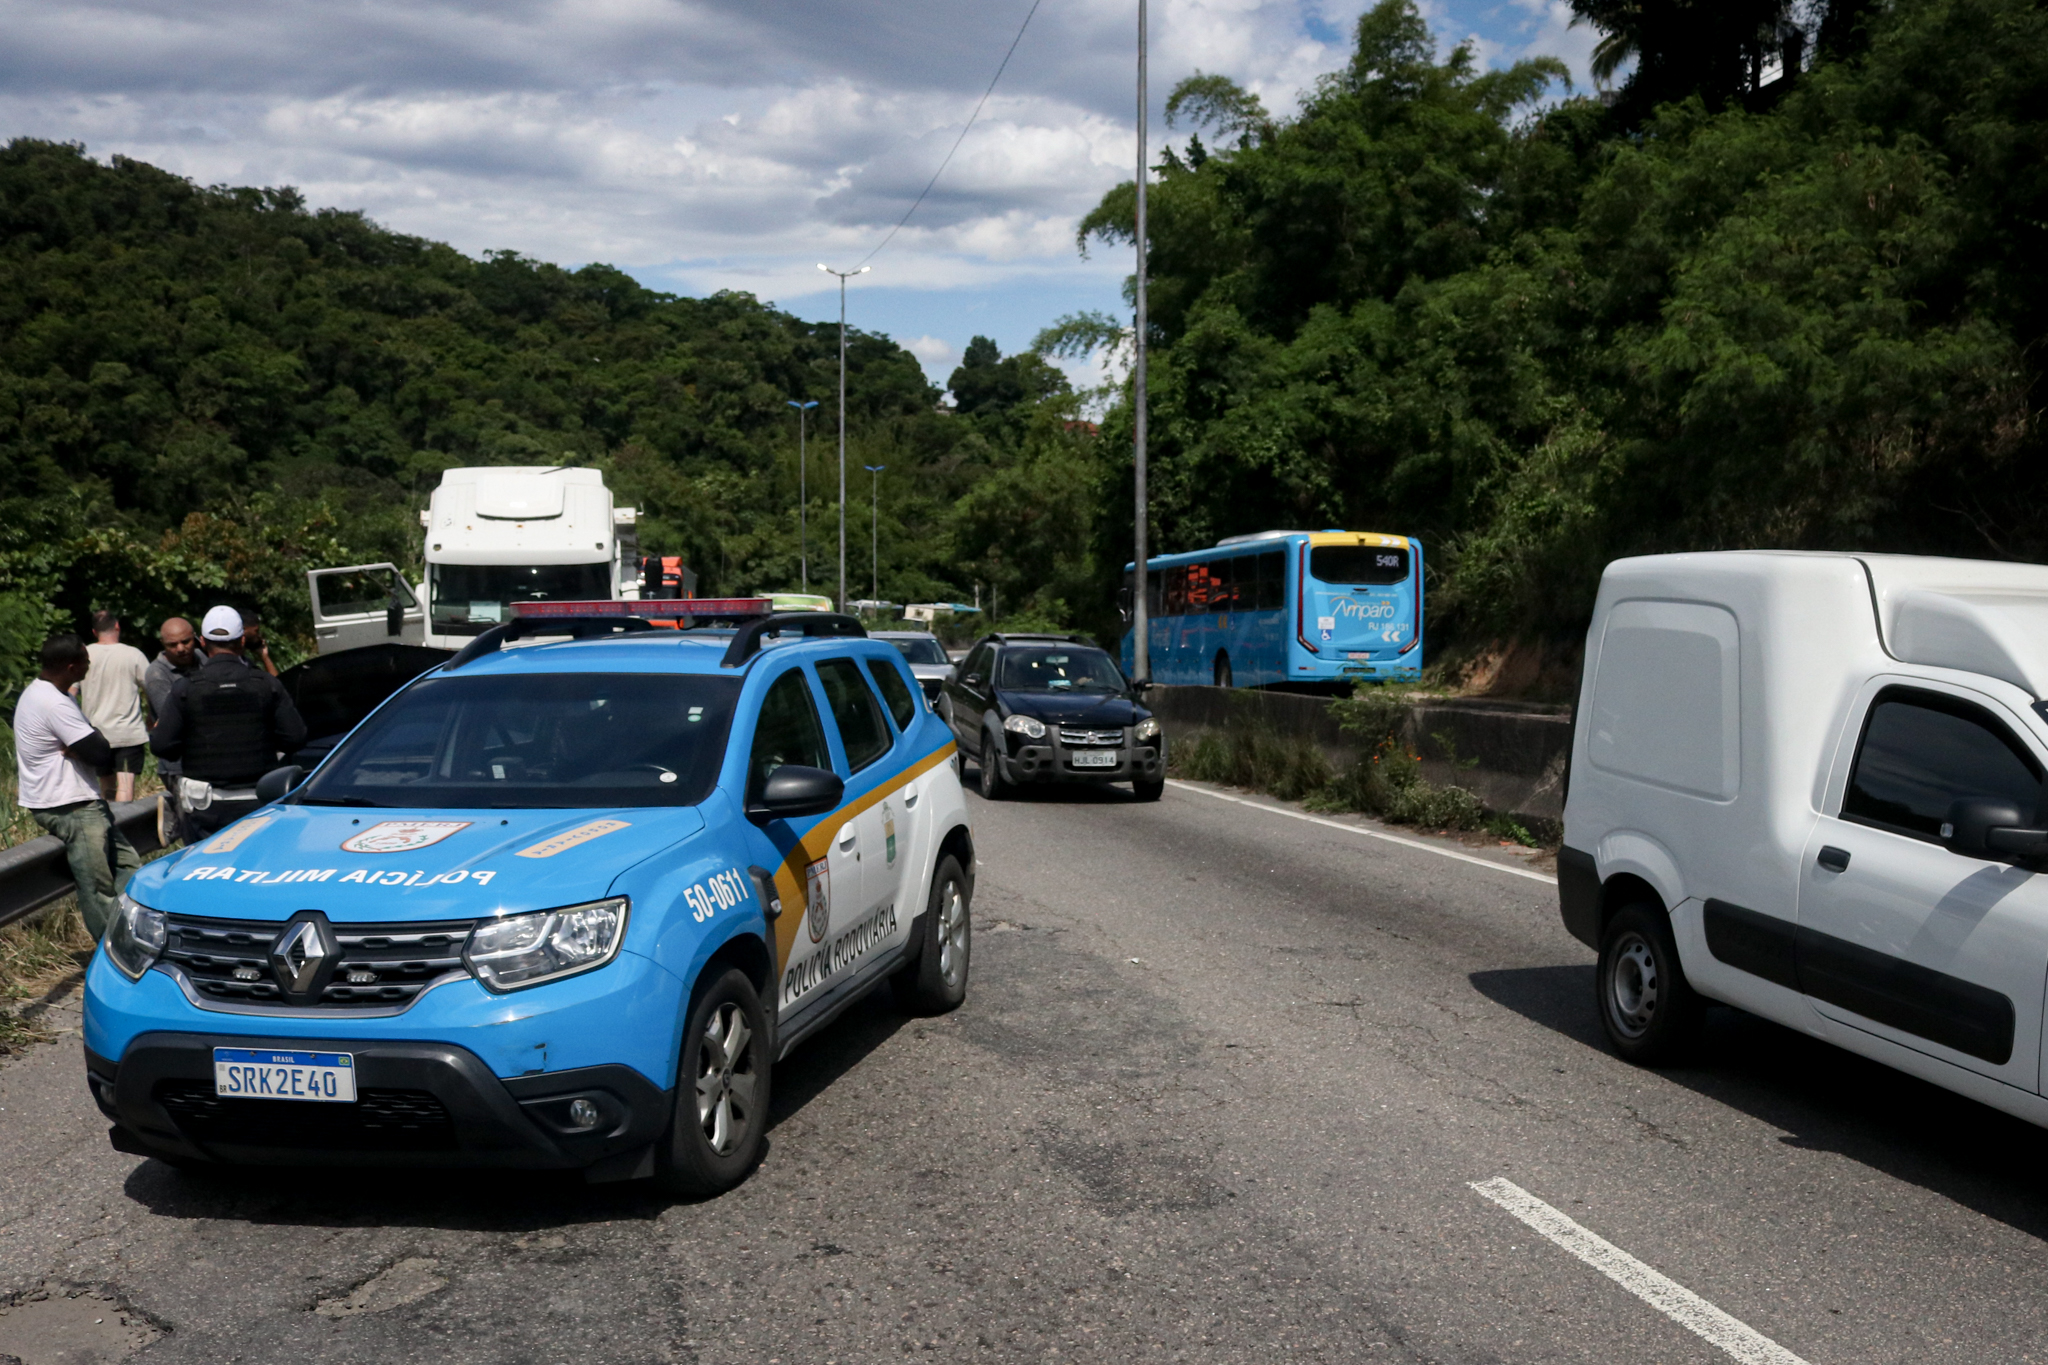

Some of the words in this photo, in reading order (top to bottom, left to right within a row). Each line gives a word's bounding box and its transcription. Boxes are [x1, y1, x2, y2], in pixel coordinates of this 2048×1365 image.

[1376, 555, 1399, 567] 540R
[1332, 599, 1395, 621] Amparo
[1368, 622, 1379, 631] RJ
[682, 867, 749, 923] 50-0611
[272, 1055, 296, 1064] BRASIL
[228, 1065, 338, 1098] SRK2E40
[219, 1084, 228, 1093] BR
